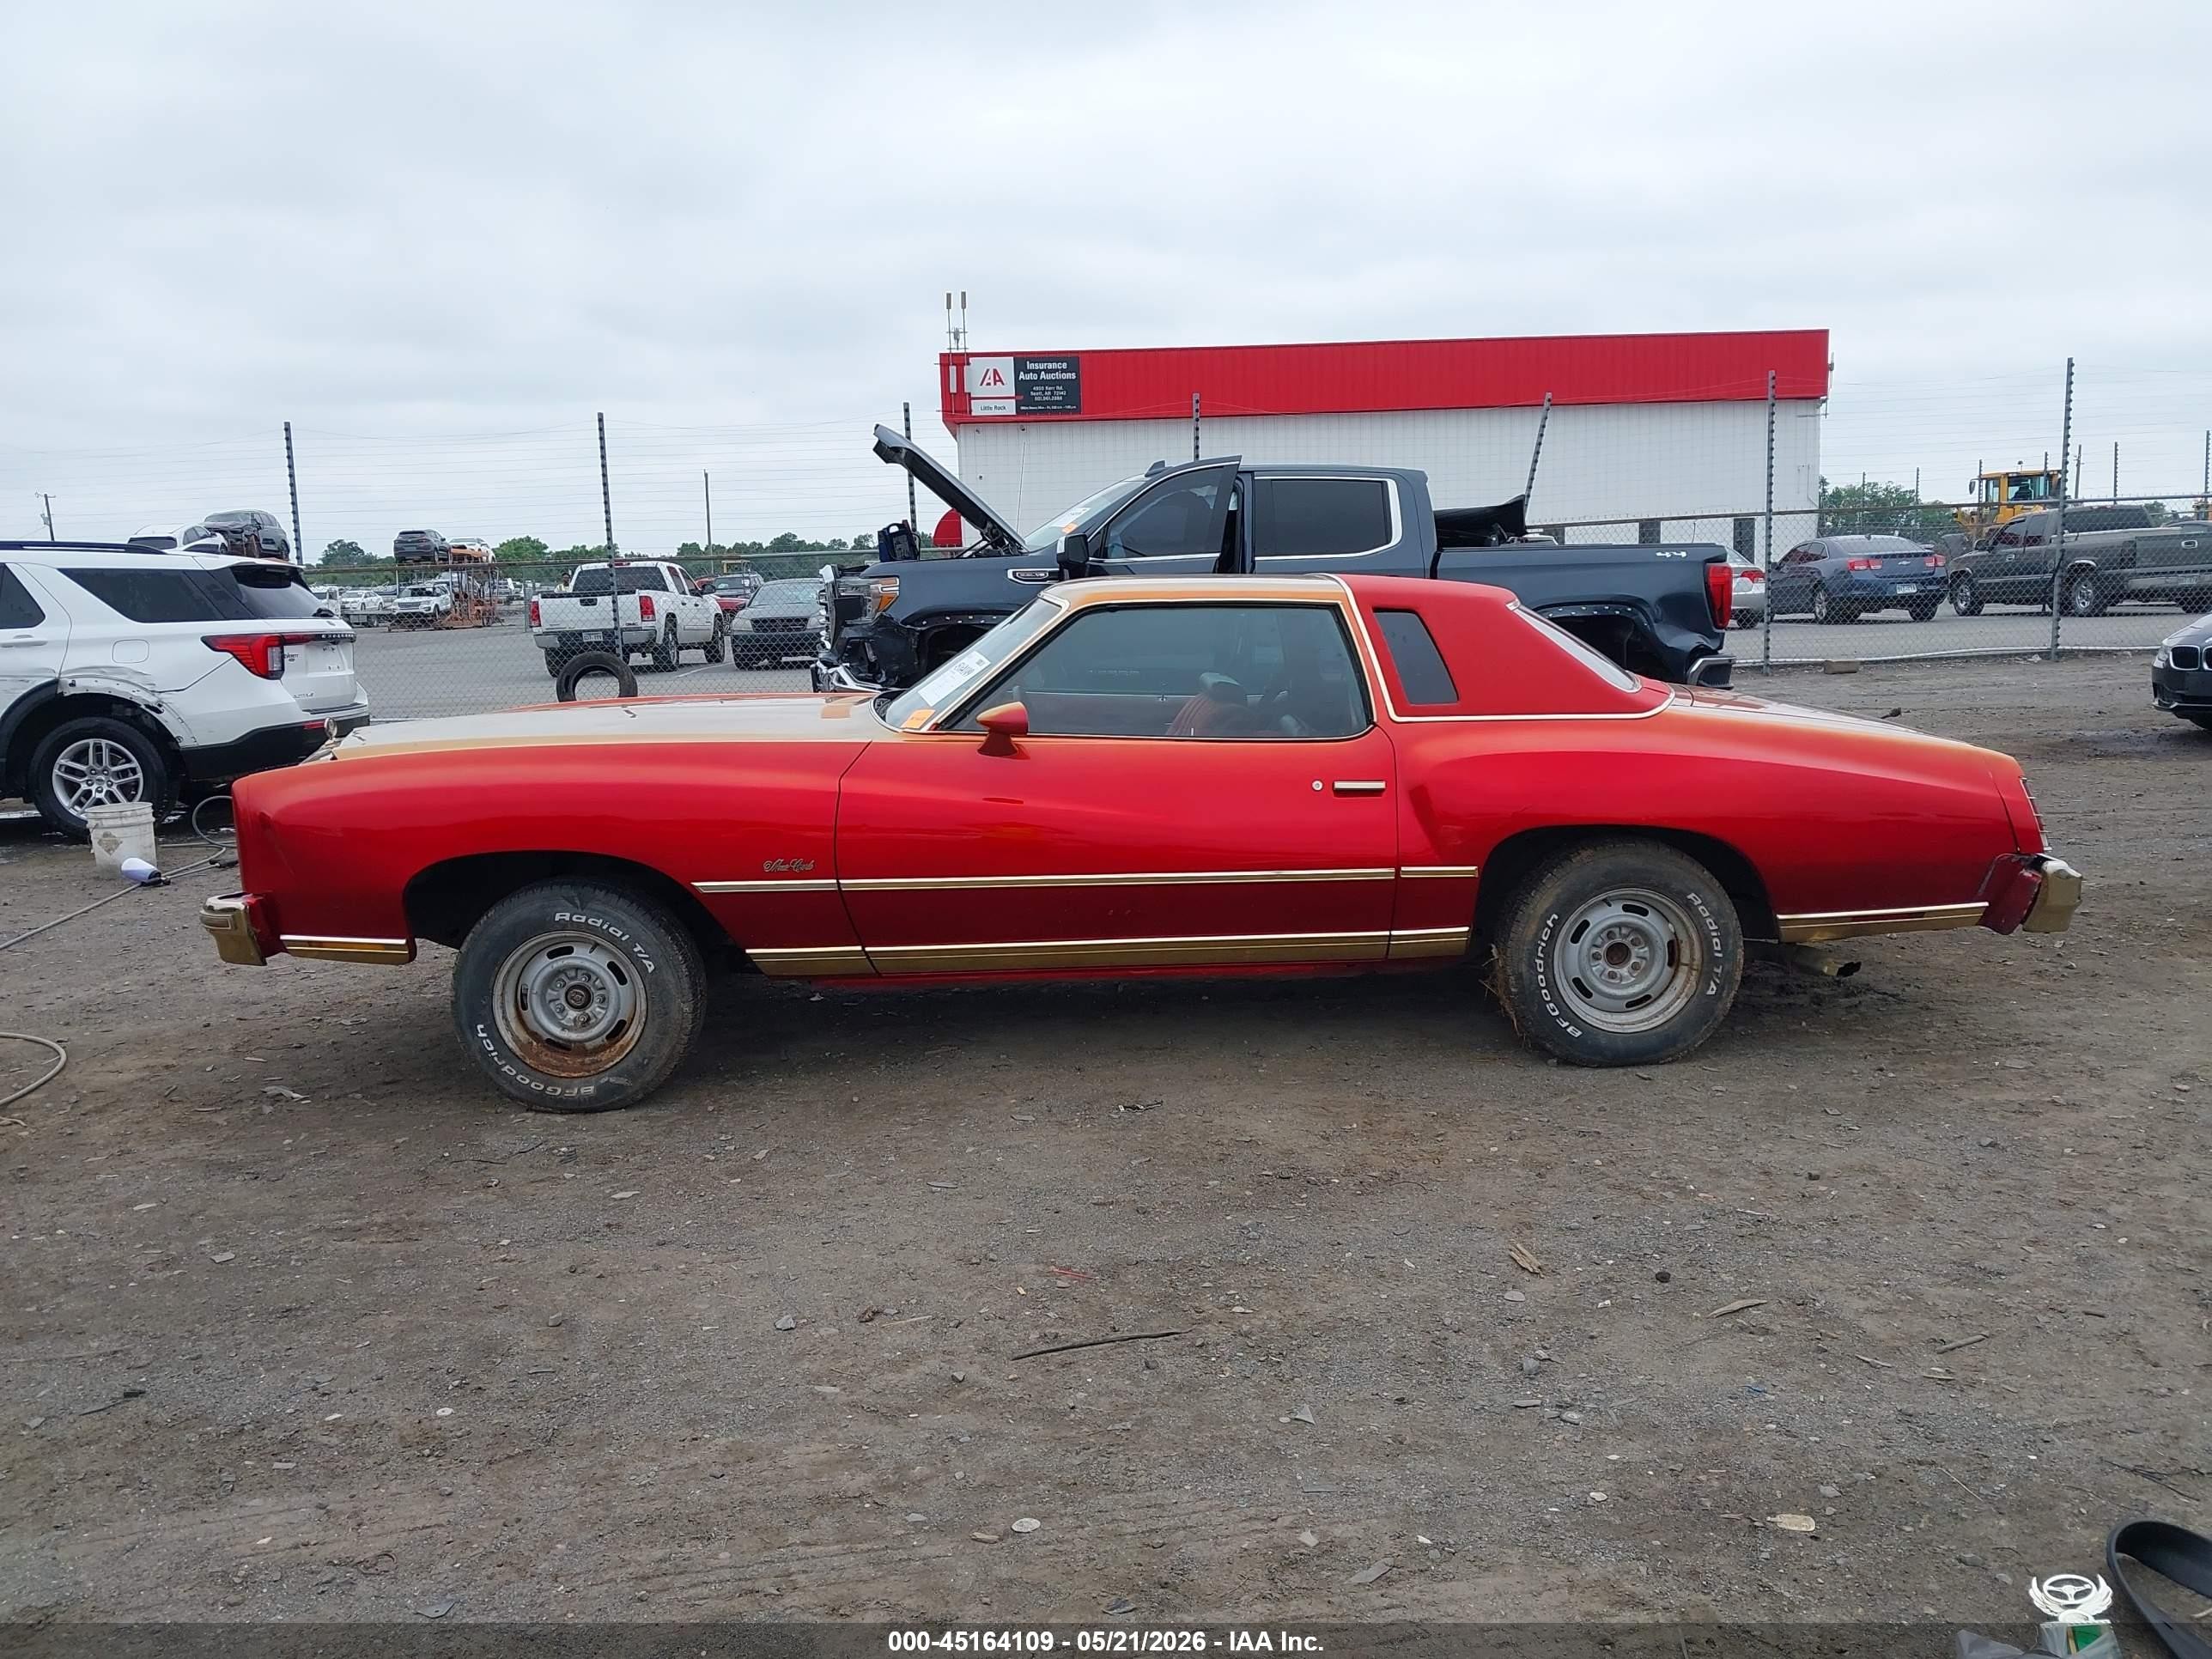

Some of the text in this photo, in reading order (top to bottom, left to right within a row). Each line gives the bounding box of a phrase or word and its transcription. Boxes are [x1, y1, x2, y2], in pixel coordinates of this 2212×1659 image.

[1018, 370, 1077, 380] Auto Auctions
[1026, 361, 1067, 369] Insurance
[555, 912, 655, 974] Radial T/A
[1534, 914, 1583, 1038] BFGoodrich
[1686, 892, 1723, 995] Radial T/A
[476, 1024, 595, 1097] BFGoodrich
